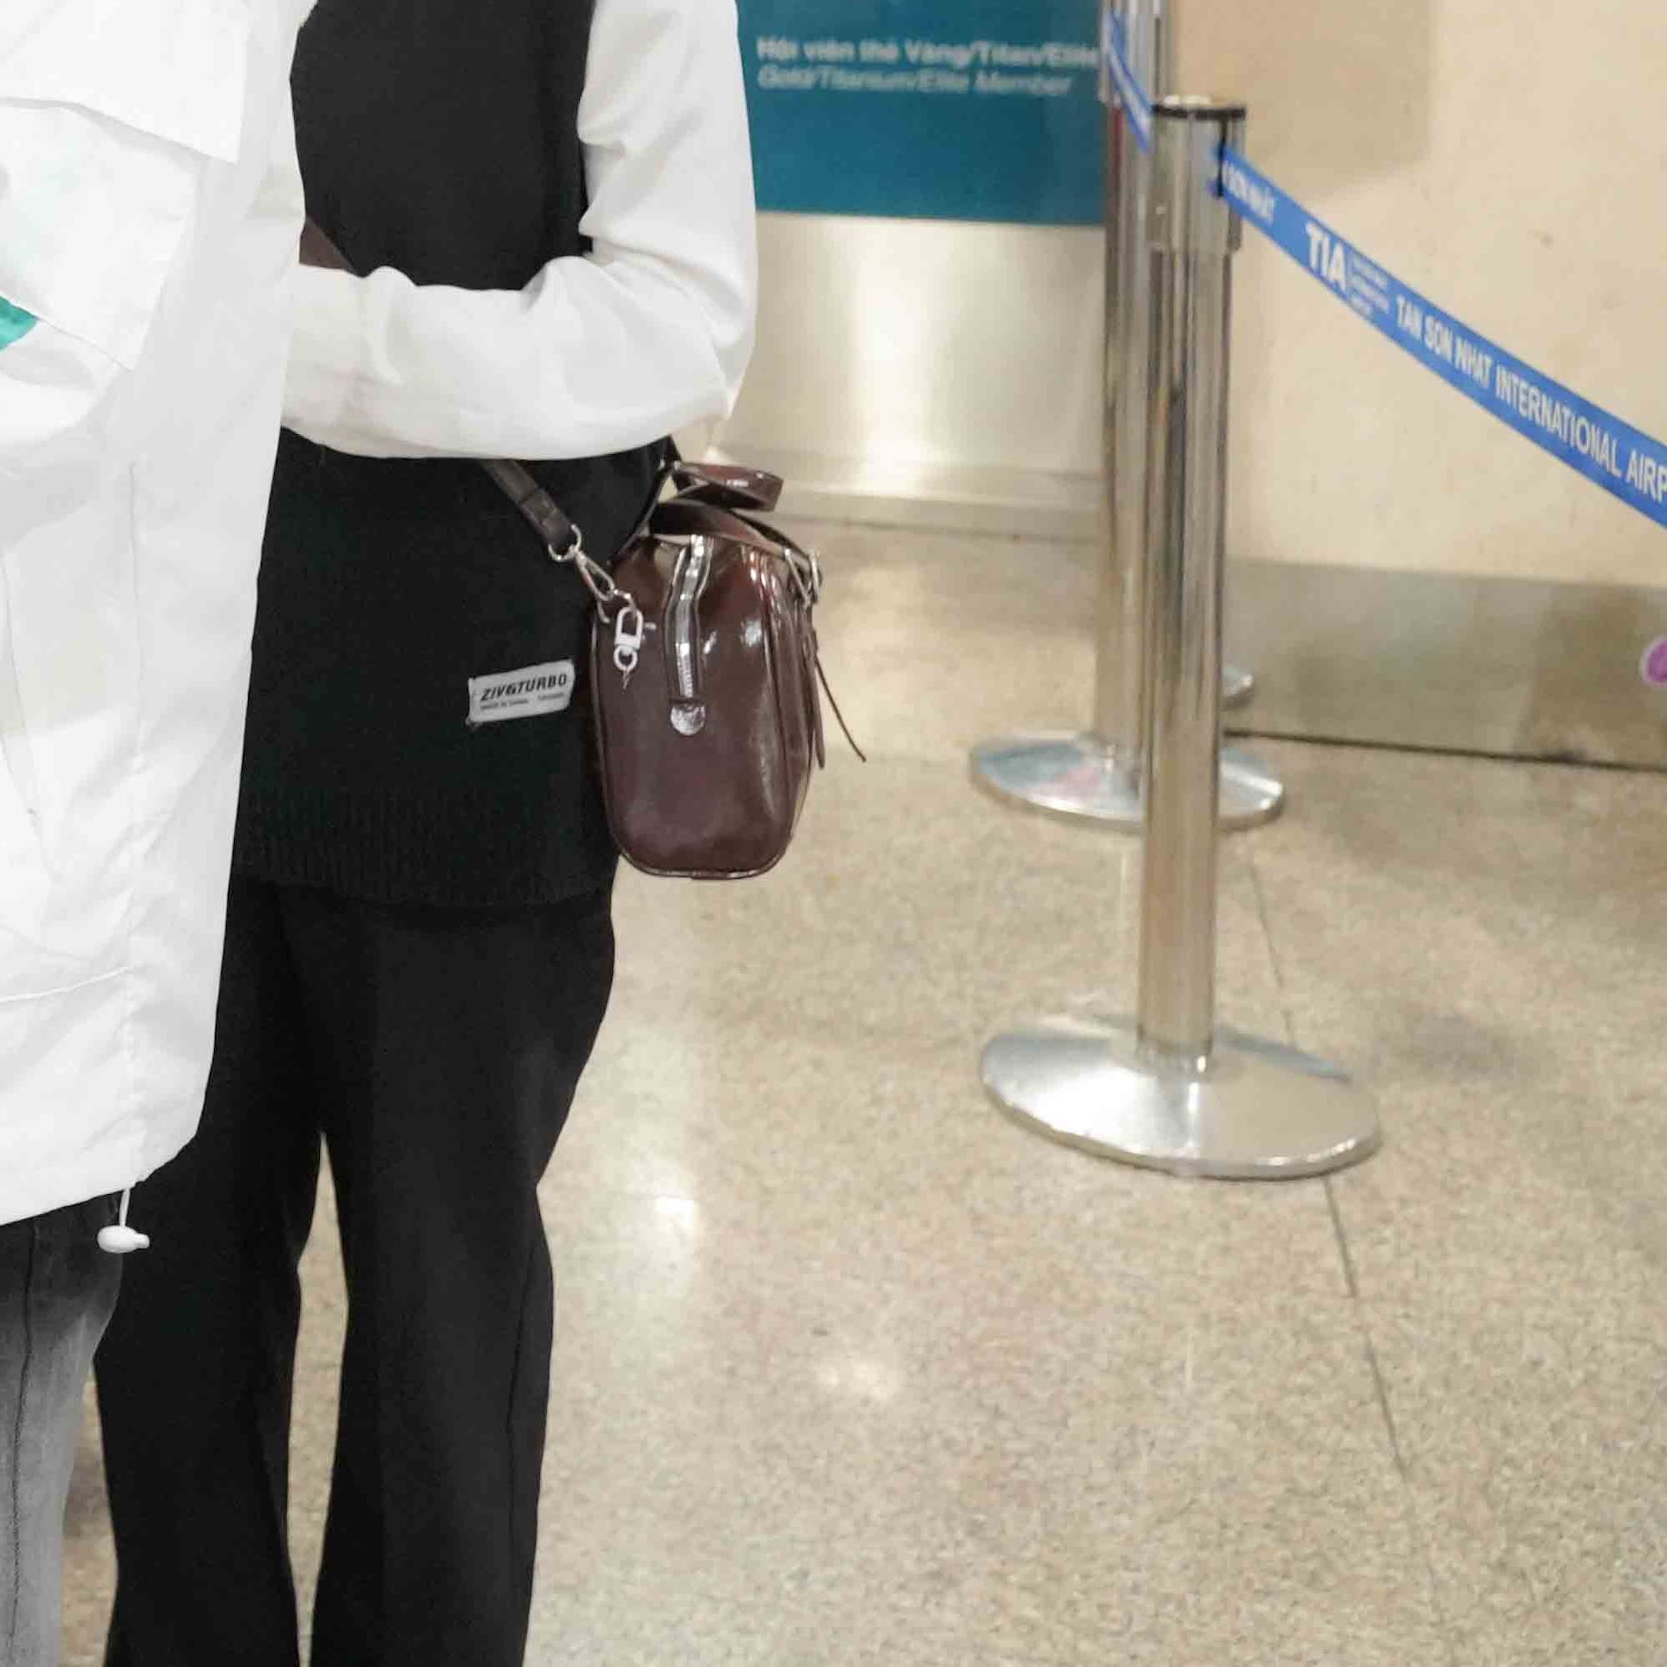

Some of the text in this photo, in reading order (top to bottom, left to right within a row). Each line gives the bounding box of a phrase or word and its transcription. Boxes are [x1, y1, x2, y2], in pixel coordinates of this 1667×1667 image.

[1305, 223, 1348, 292] TIA
[1396, 294, 1424, 342] TAN
[1424, 314, 1454, 366] SON
[1455, 335, 1494, 390] NHAT
[1495, 364, 1623, 479] INTERNATIONAL
